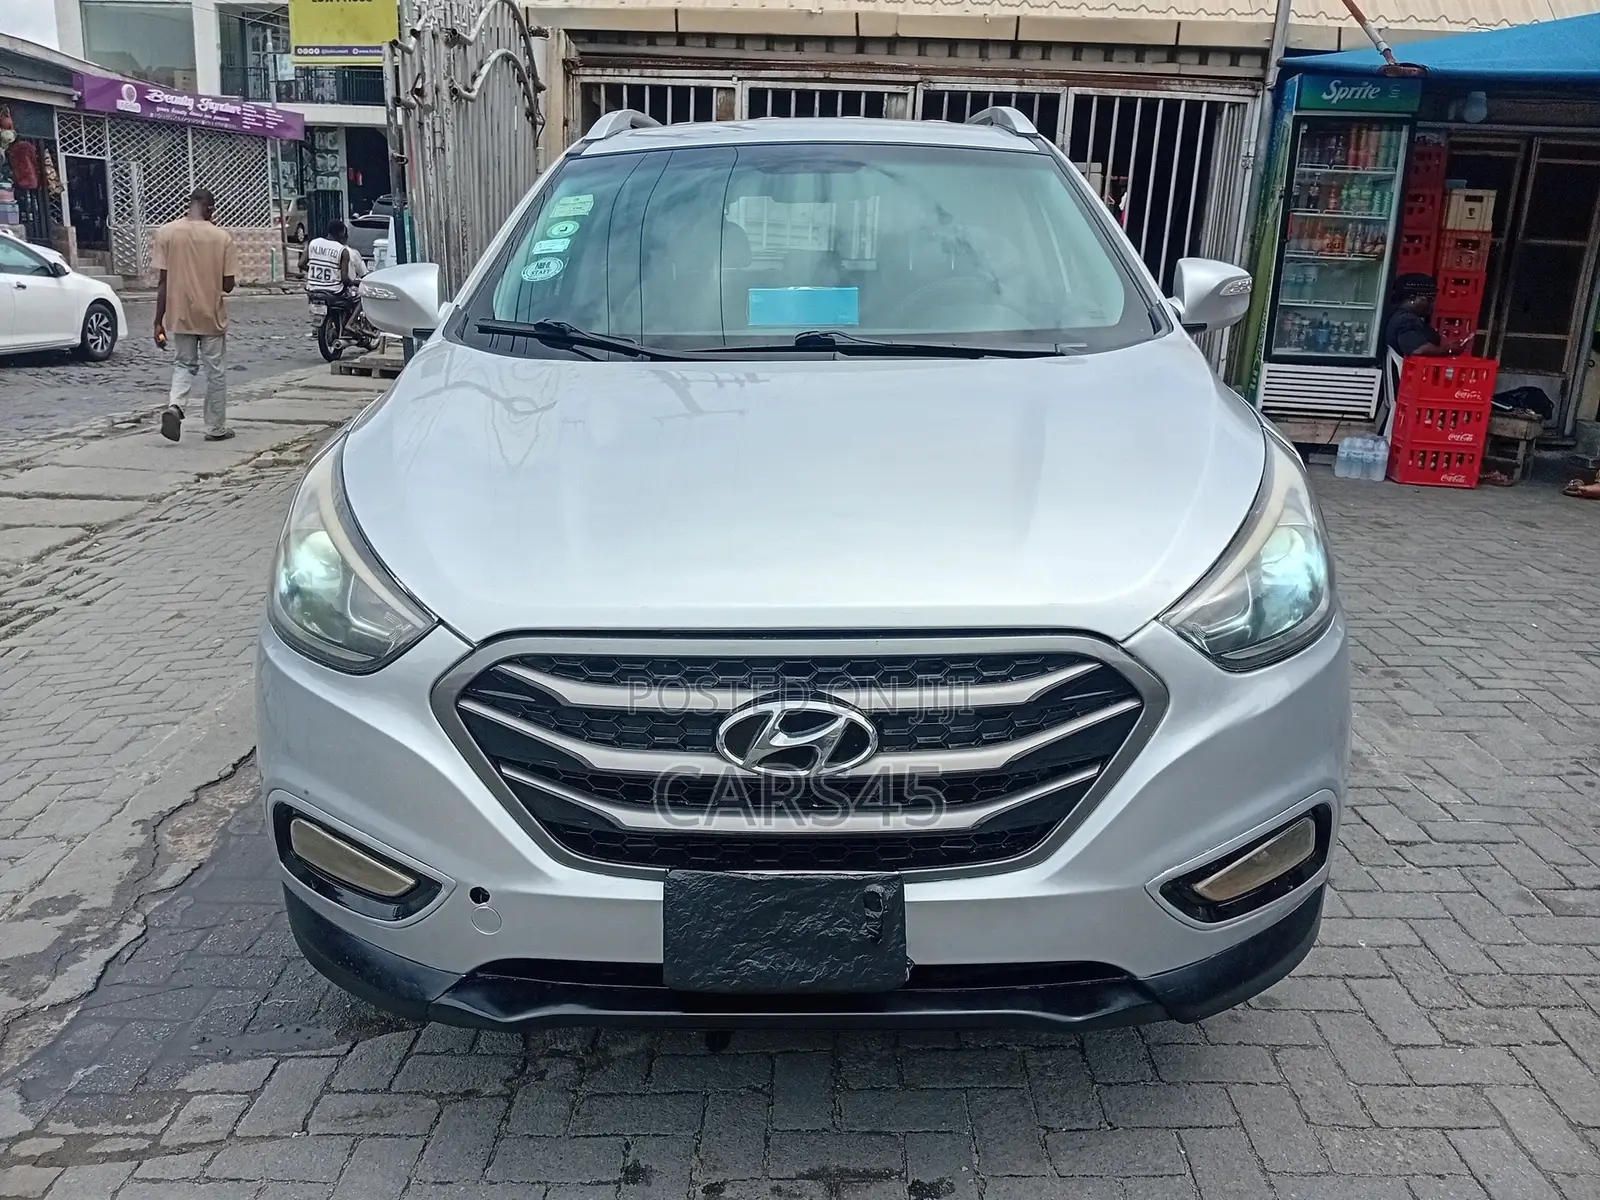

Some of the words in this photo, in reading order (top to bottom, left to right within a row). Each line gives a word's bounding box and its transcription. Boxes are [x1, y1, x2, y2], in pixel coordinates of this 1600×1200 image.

[144, 88, 195, 110] Beauty
[197, 97, 242, 114] Signature
[1321, 79, 1381, 104] Sprite
[310, 265, 332, 281] 126
